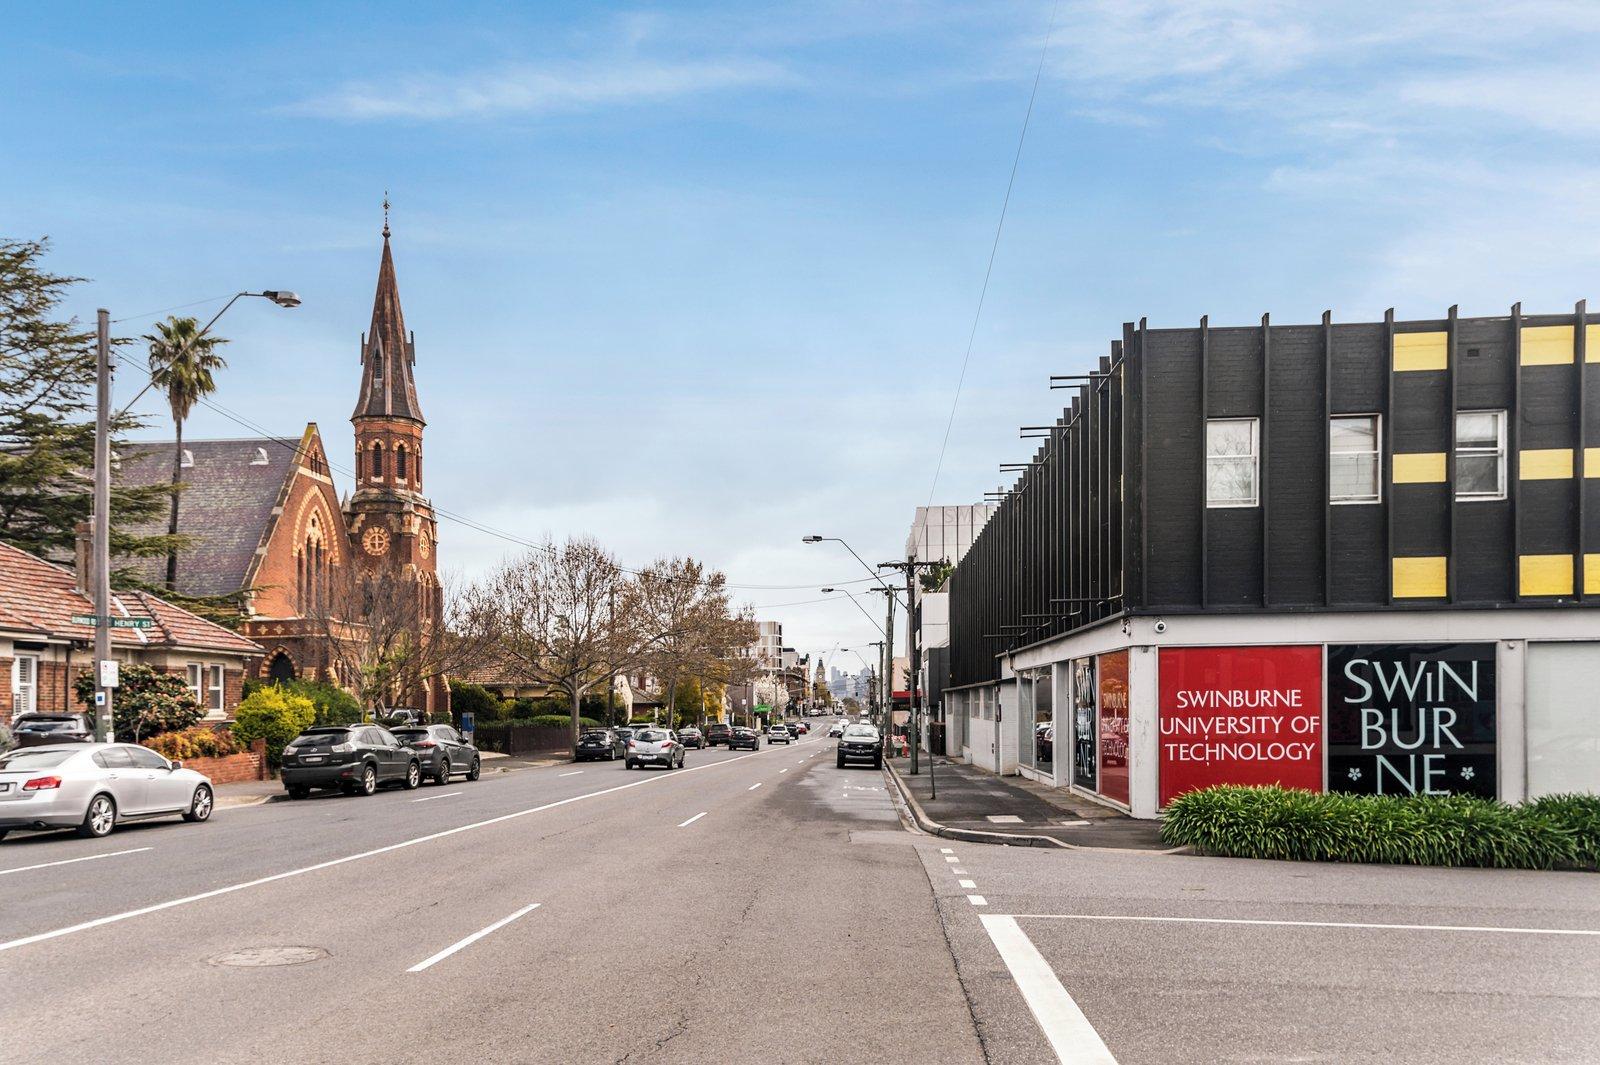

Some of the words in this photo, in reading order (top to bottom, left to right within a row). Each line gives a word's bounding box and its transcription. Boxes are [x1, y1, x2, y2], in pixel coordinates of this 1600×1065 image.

[114, 620, 139, 628] HENRY
[142, 620, 151, 628] ST
[1176, 689, 1303, 708] SWINBURNE
[1159, 716, 1284, 735] UNIVERSITY
[1290, 715, 1320, 734] OF
[1360, 707, 1465, 750] BUR
[1164, 742, 1316, 761] TECHNOLOGY
[1375, 754, 1451, 796] NE
